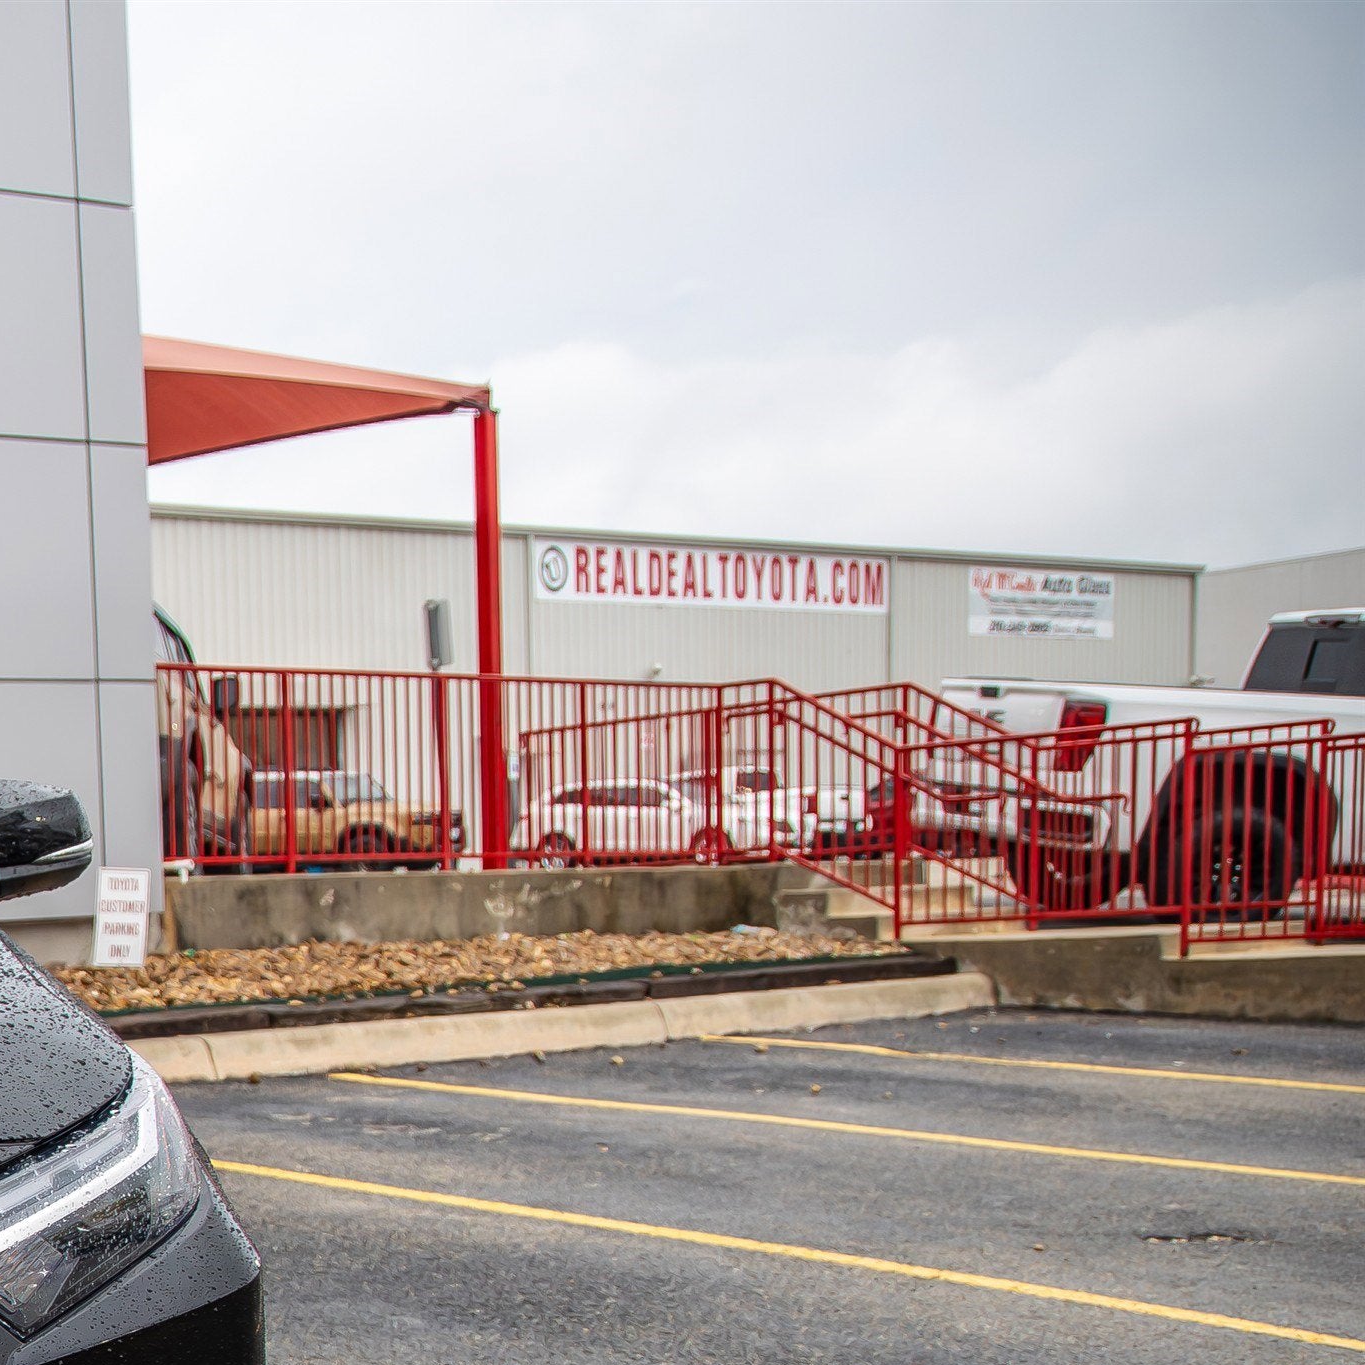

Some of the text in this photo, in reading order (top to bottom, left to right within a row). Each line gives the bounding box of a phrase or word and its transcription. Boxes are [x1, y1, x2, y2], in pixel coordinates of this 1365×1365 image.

[574, 544, 885, 606] REALDEALTOYOTA.COM
[109, 876, 140, 892] TOYOTA
[101, 899, 146, 913] CUSTOMER
[103, 922, 140, 936] PARKING
[110, 944, 131, 959] ONLY
